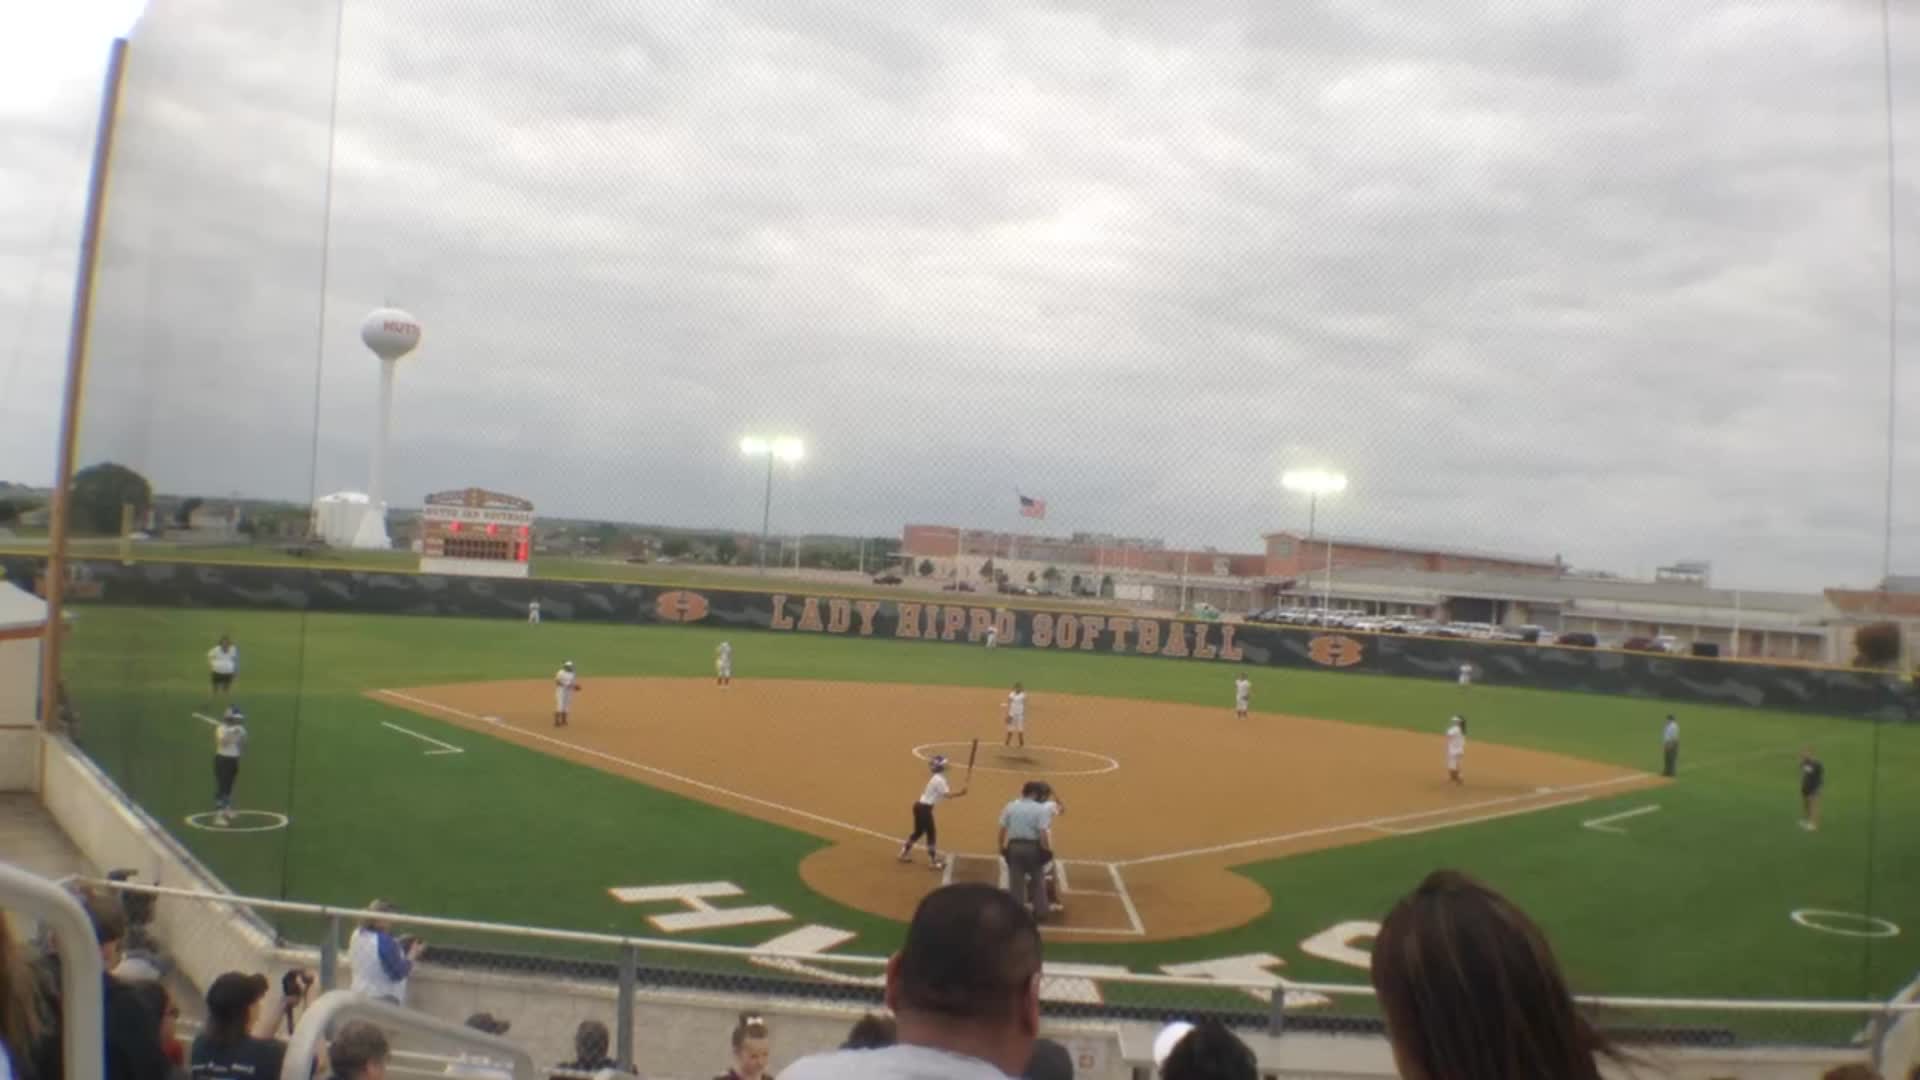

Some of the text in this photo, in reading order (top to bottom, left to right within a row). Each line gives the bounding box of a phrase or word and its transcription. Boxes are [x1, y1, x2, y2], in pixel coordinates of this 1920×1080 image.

[770, 593, 1243, 661] LADY HIPPO SOFTBALL
